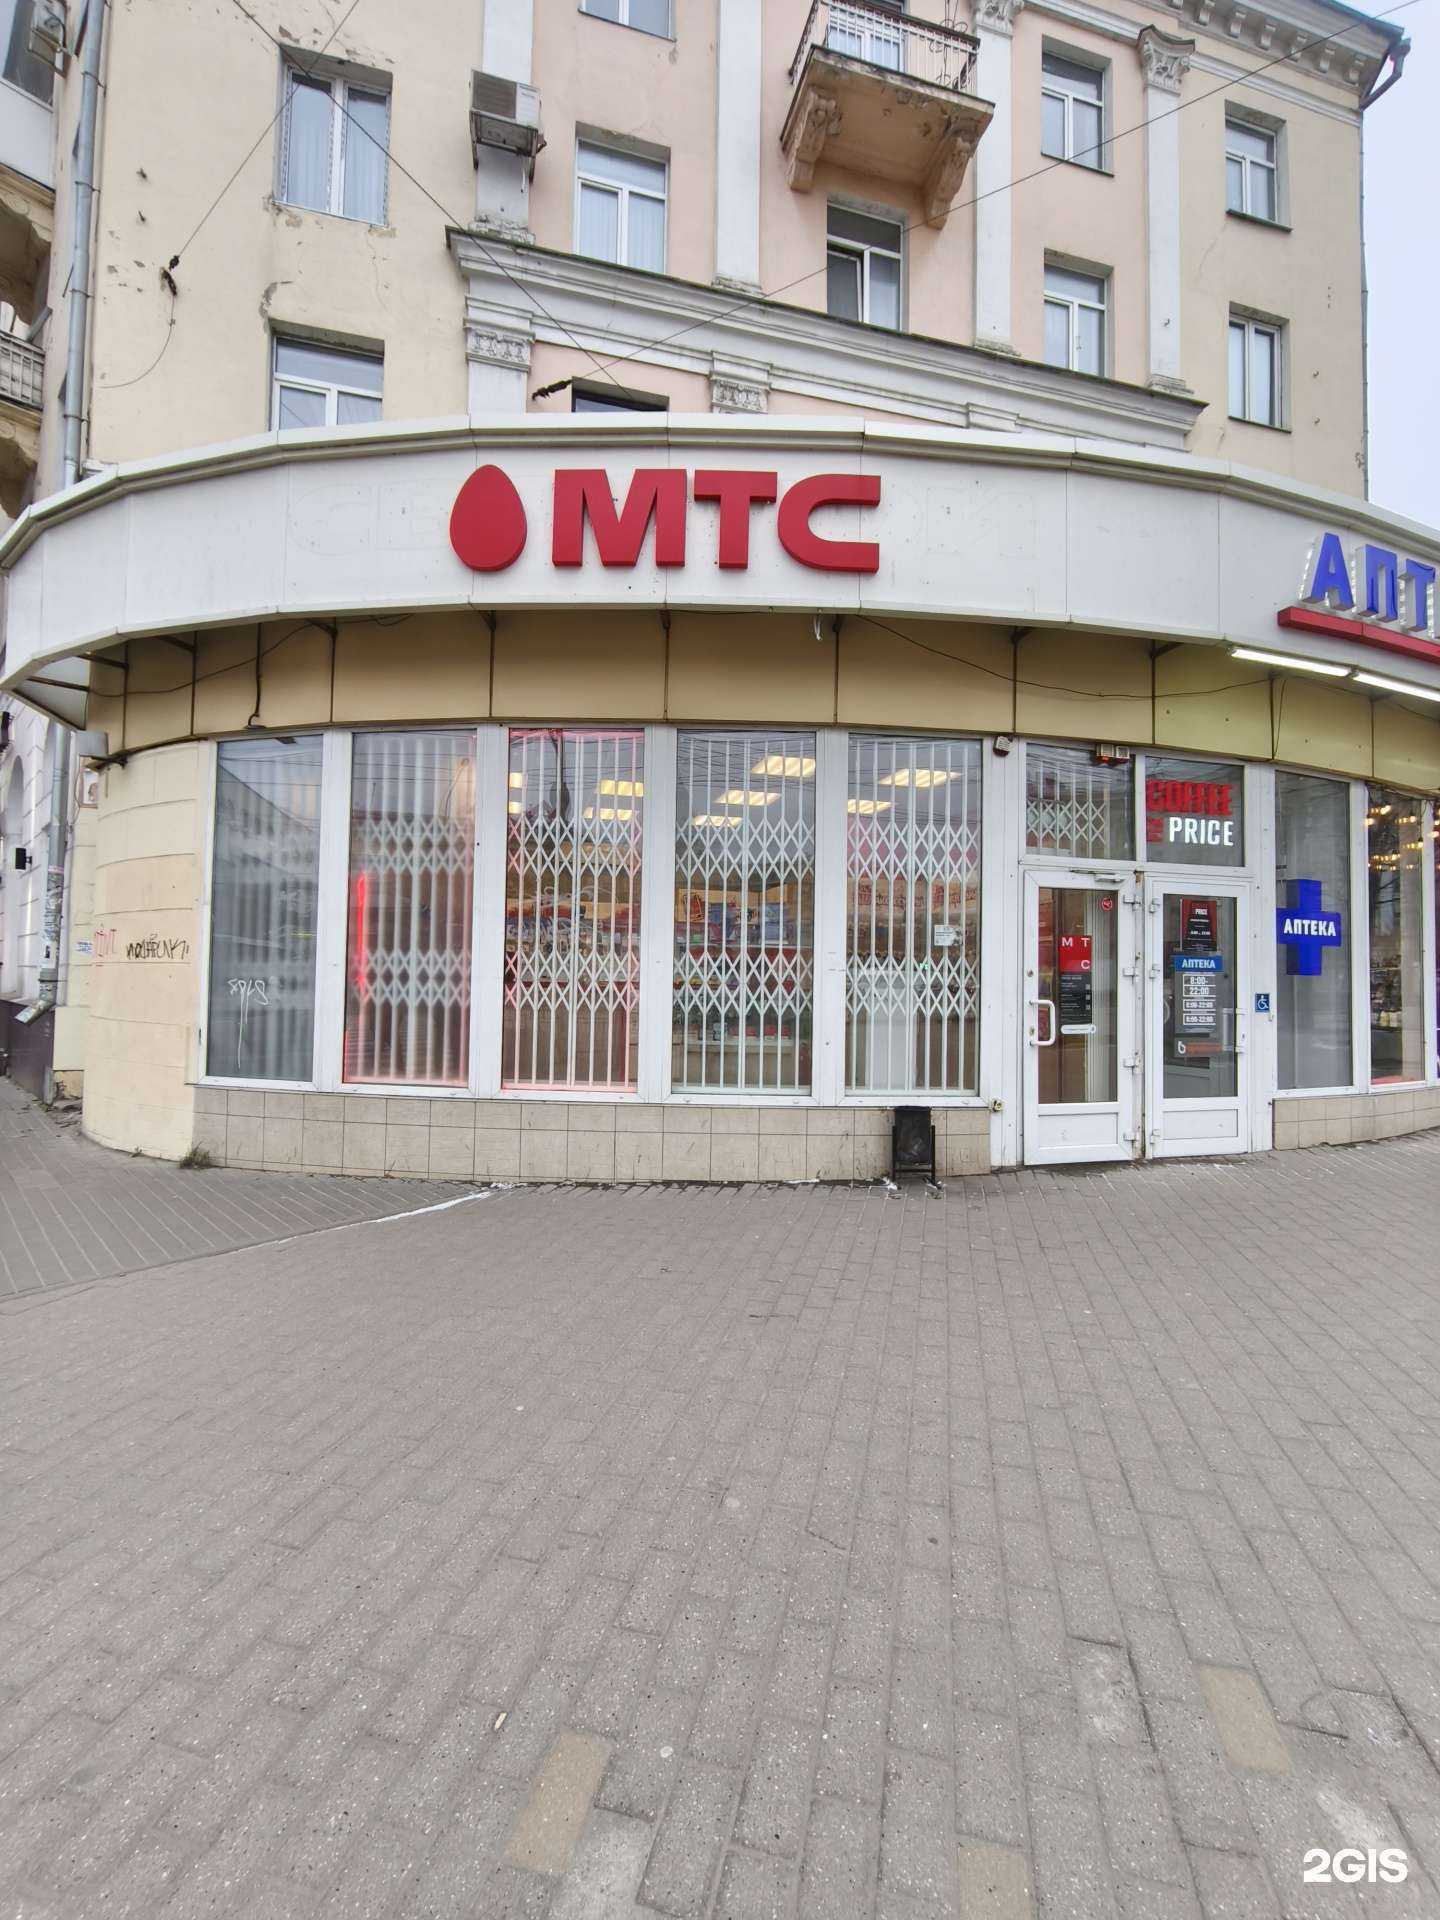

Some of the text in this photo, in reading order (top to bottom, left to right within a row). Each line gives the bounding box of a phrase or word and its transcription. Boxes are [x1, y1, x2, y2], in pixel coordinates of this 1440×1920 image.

[552, 469, 882, 574] МТС
[1303, 532, 1440, 638] АПТ
[1169, 816, 1234, 846] PRICE
[1283, 918, 1337, 937] АПТЕКА
[1182, 959, 1216, 969] АПТЕКА
